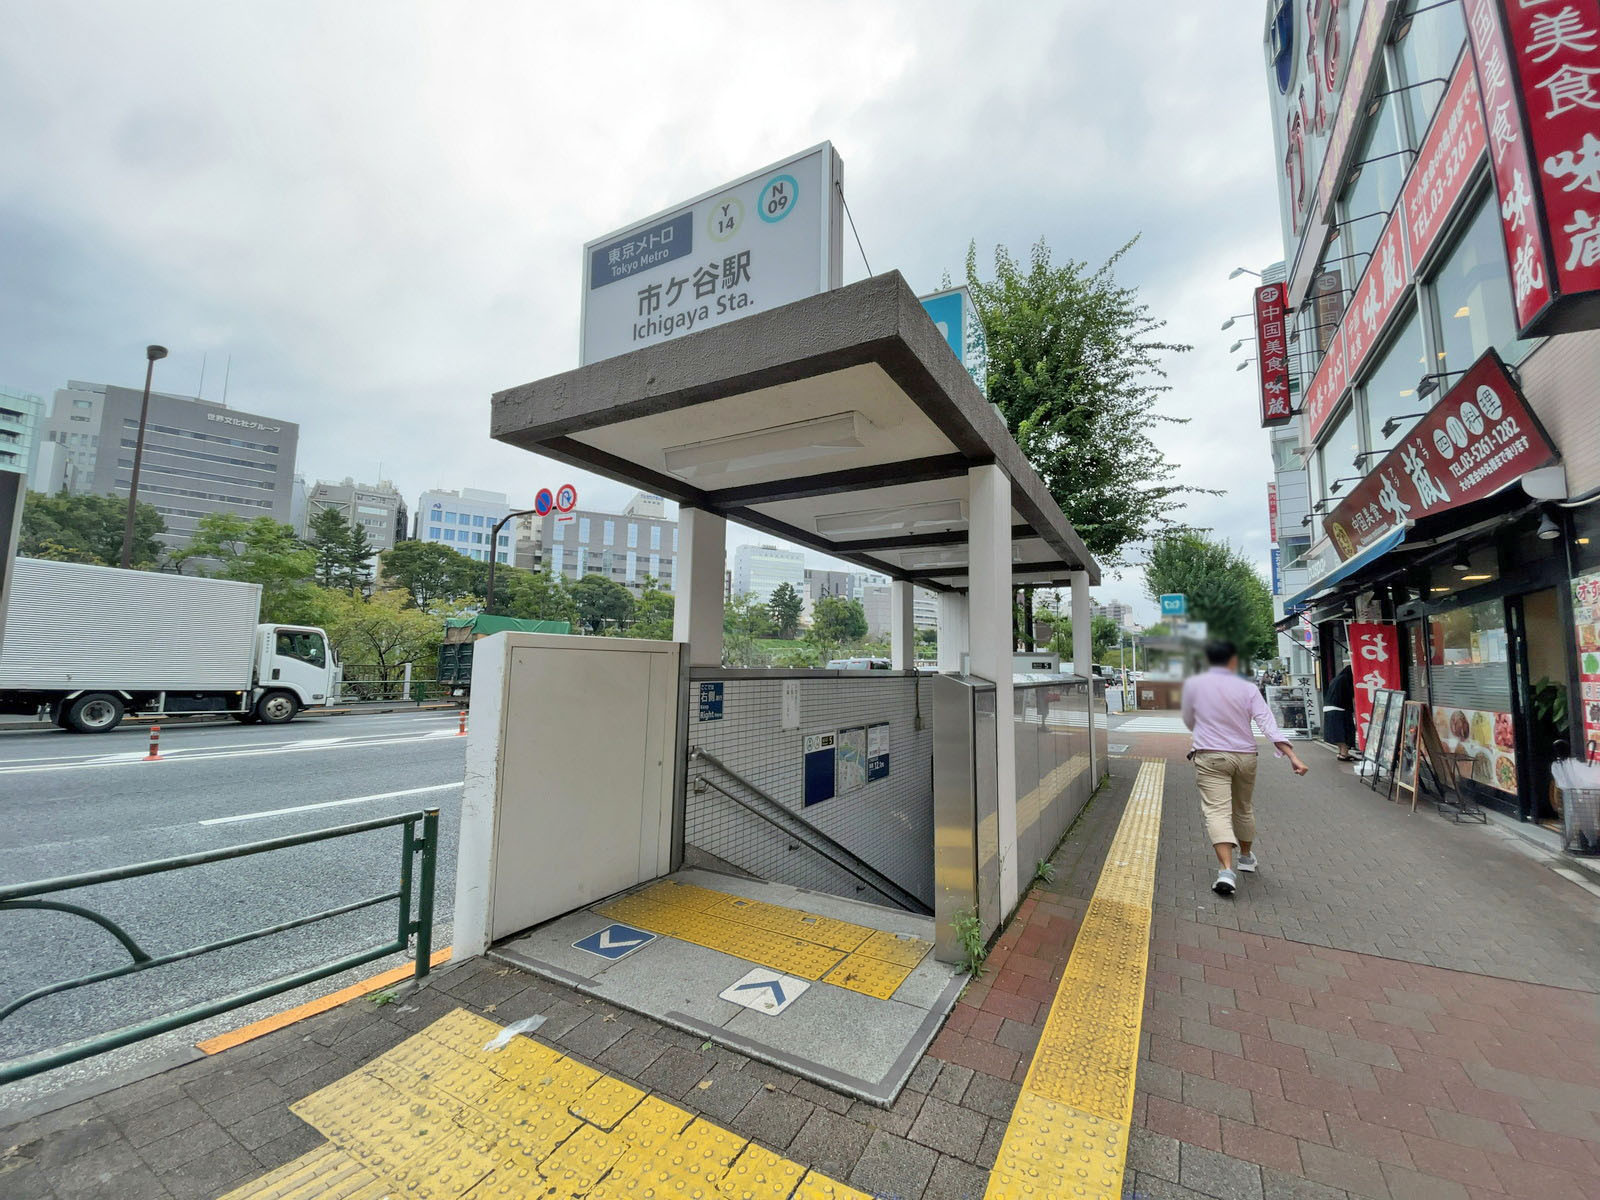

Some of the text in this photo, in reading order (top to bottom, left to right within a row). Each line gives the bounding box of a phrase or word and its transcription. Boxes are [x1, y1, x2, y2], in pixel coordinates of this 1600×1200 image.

[1519, 0, 1600, 119] 美食
[767, 195, 788, 214] 09
[772, 182, 783, 197] N
[718, 216, 735, 233] 14
[721, 203, 730, 217] Y
[608, 226, 674, 266] 東京メトロ
[611, 248, 669, 277] Tokyo Metro
[637, 249, 751, 317] 市ケ谷駅
[633, 292, 754, 341] Ichigaya Sta.
[1262, 289, 1289, 416] 2F 中国美食 味蔵
[207, 412, 281, 433] 世界文化社グループ
[1435, 388, 1502, 454] 四川料理
